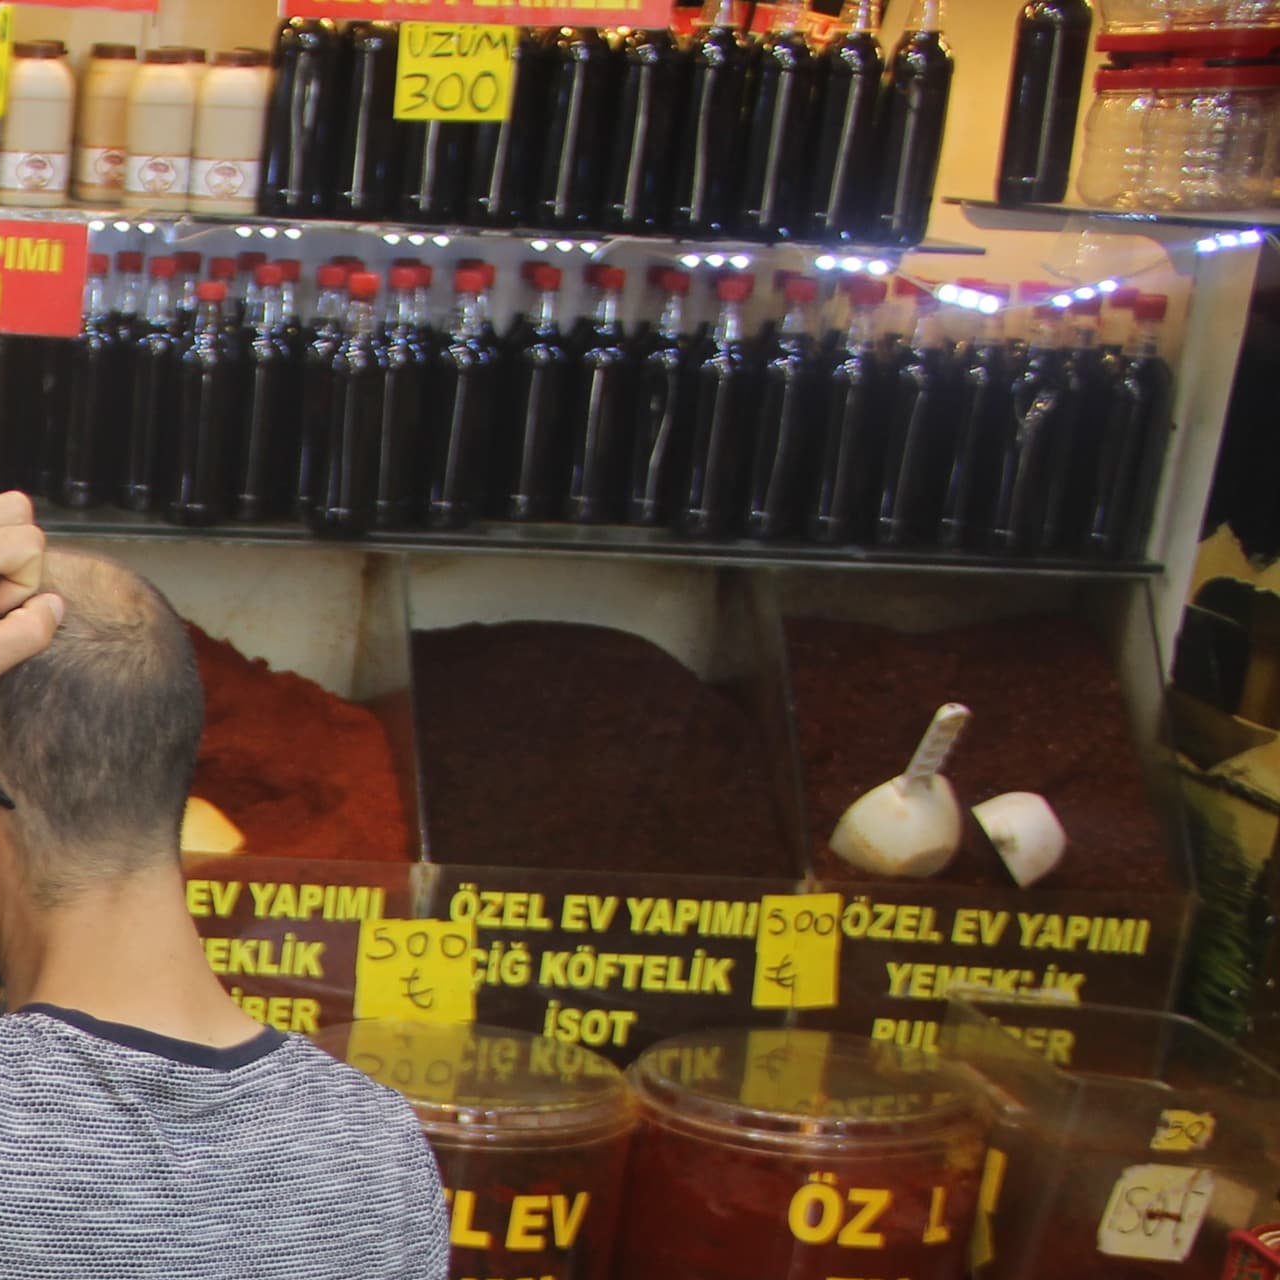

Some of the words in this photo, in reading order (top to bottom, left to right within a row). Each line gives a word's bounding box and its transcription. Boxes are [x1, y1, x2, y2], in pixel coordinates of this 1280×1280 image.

[401, 70, 500, 114] 300
[185, 878, 241, 917] EV
[248, 881, 387, 922] YAPIMI
[448, 882, 553, 931] ÖZEL
[560, 894, 619, 933] EV
[626, 897, 761, 939] YAPIMI
[768, 907, 836, 937] 500
[365, 927, 469, 962] 500
[842, 895, 944, 944] ÖZEL
[950, 908, 1011, 945] EV
[1017, 911, 1152, 955] YAPIMI
[204, 932, 326, 977] EKLİK
[469, 940, 533, 991] ÇİĞ
[539, 943, 736, 994] KÖFTELİK
[543, 999, 637, 1047] İSOT
[504, 1191, 591, 1252] EV
